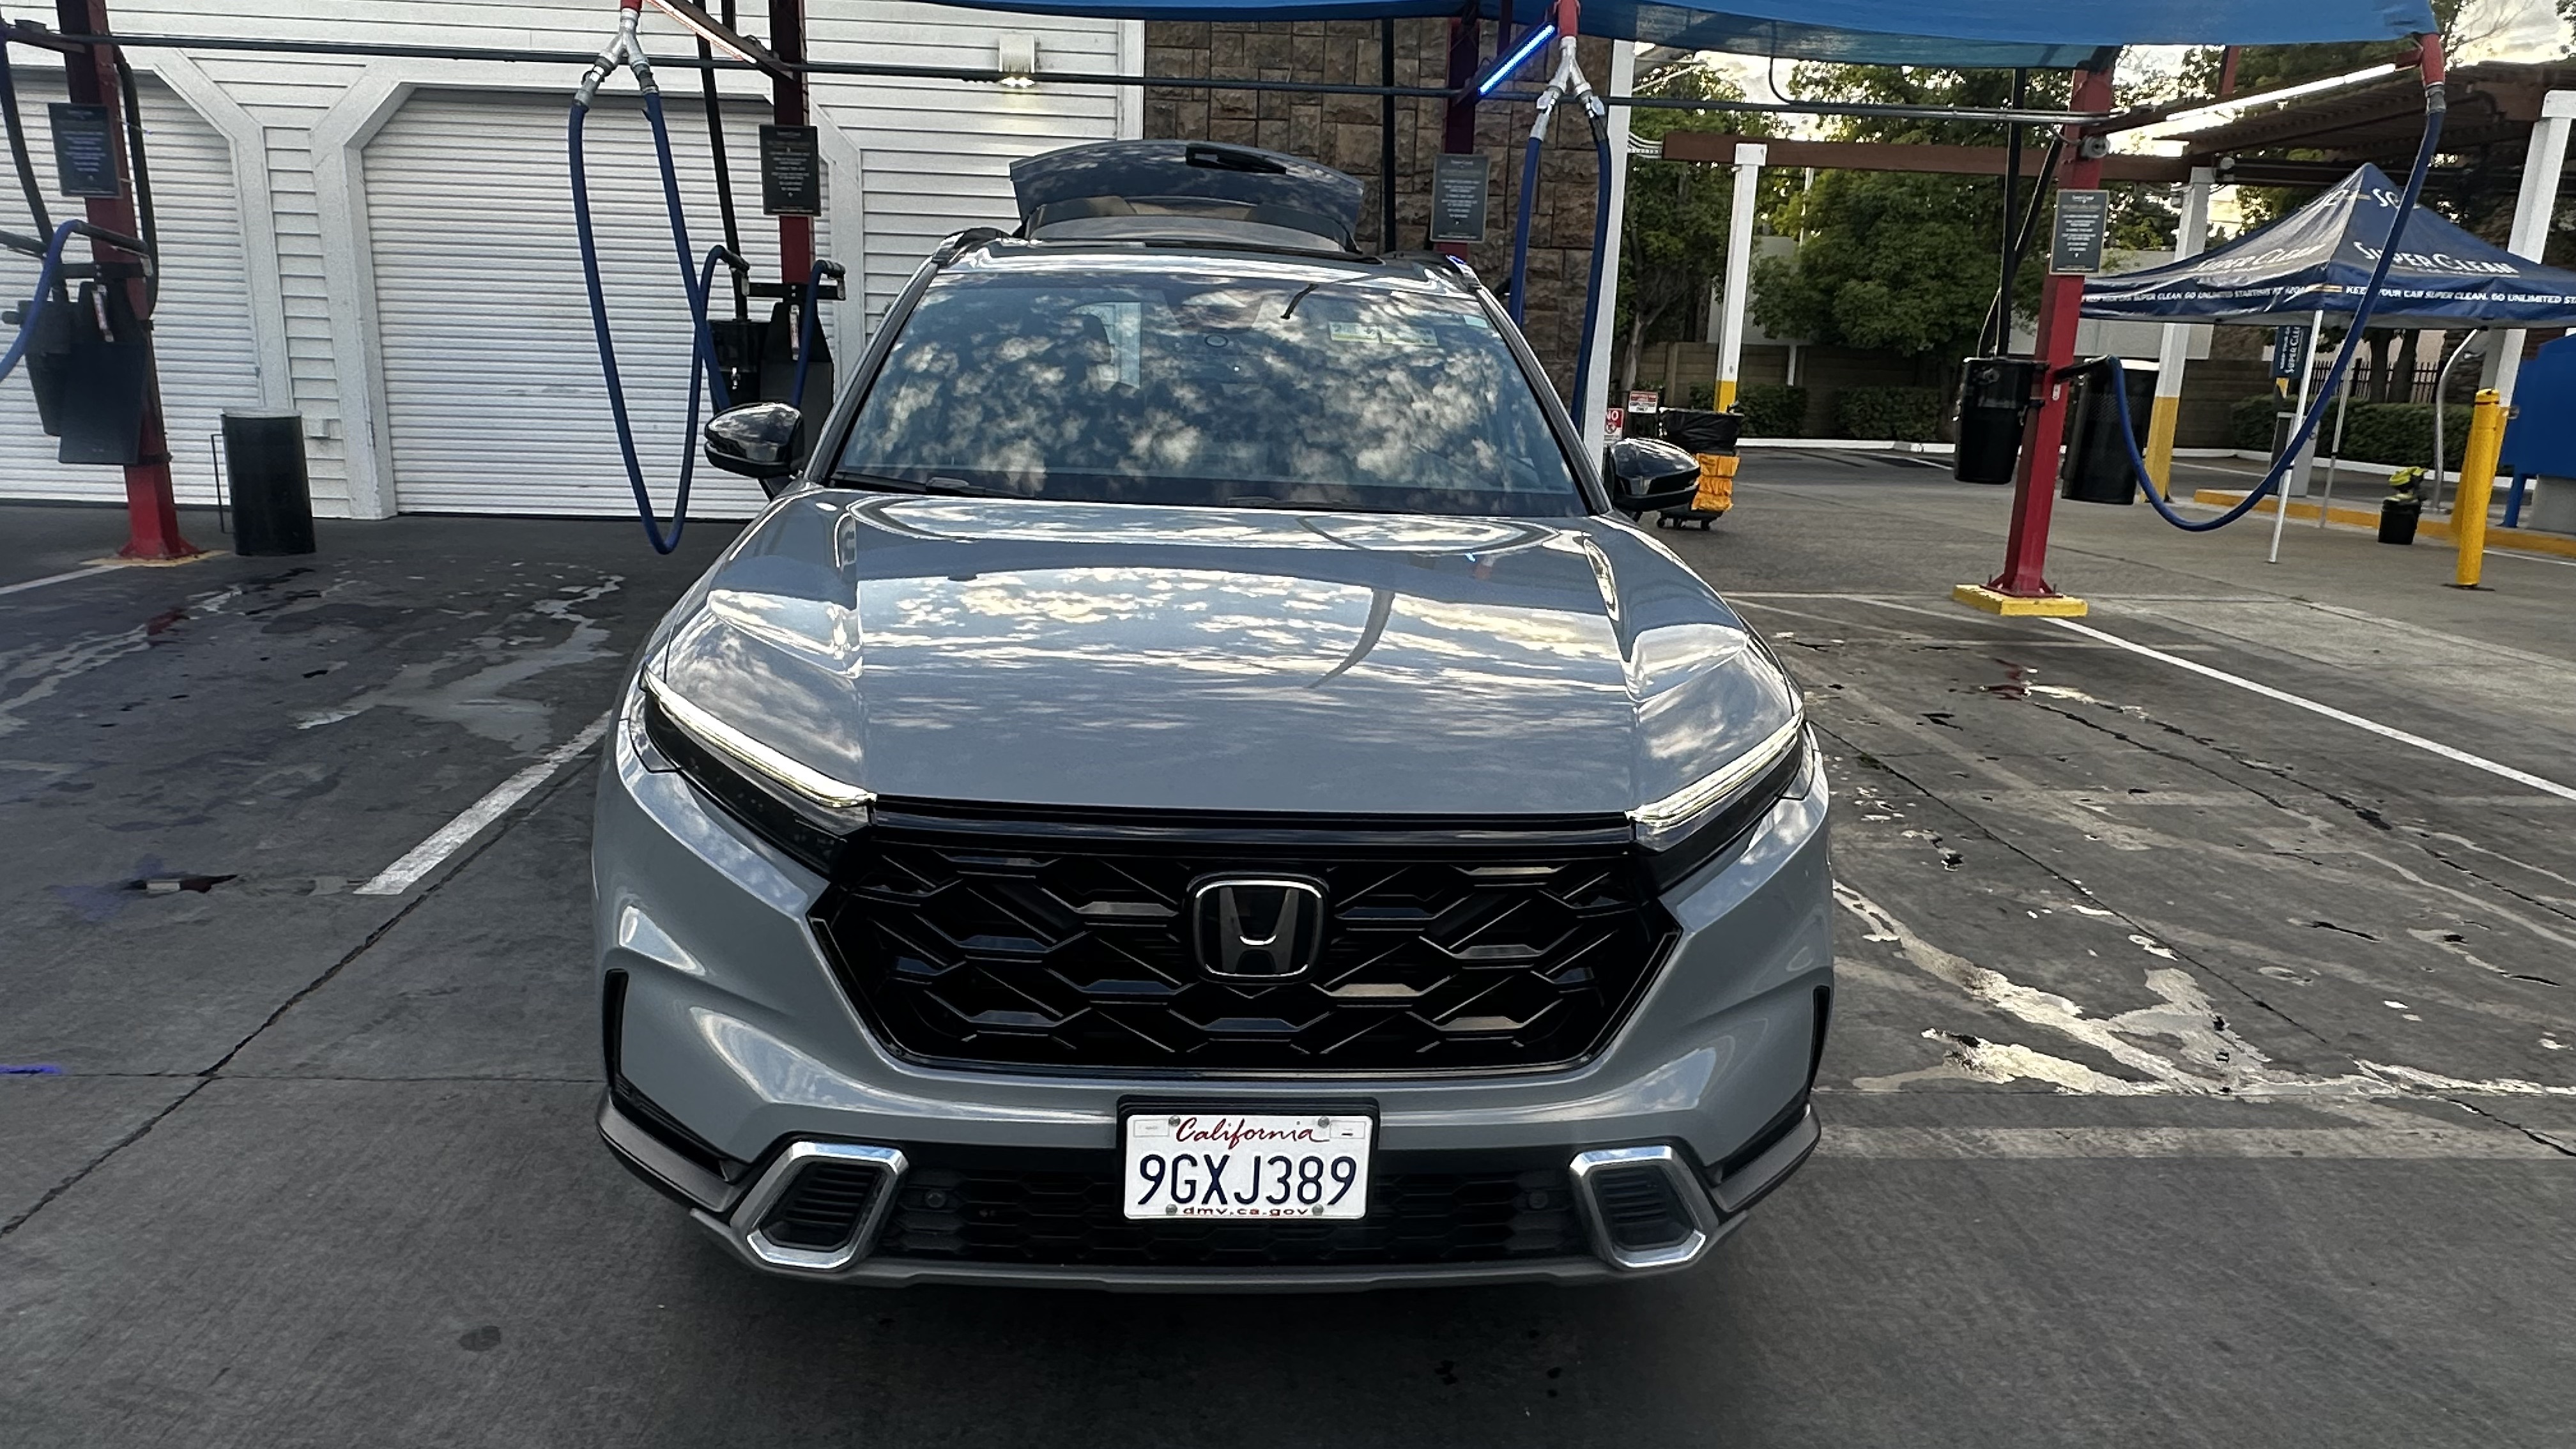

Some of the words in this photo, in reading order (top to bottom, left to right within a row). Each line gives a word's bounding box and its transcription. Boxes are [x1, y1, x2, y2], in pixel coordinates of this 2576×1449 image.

[2346, 285, 2368, 295] KEE
[2404, 290, 2424, 298] CAR
[2492, 293, 2506, 302] GO
[1176, 1117, 1330, 1149] California
[1137, 1153, 1357, 1206] 9GXJ389
[1183, 1206, 1309, 1216] dmv.ca.gov
